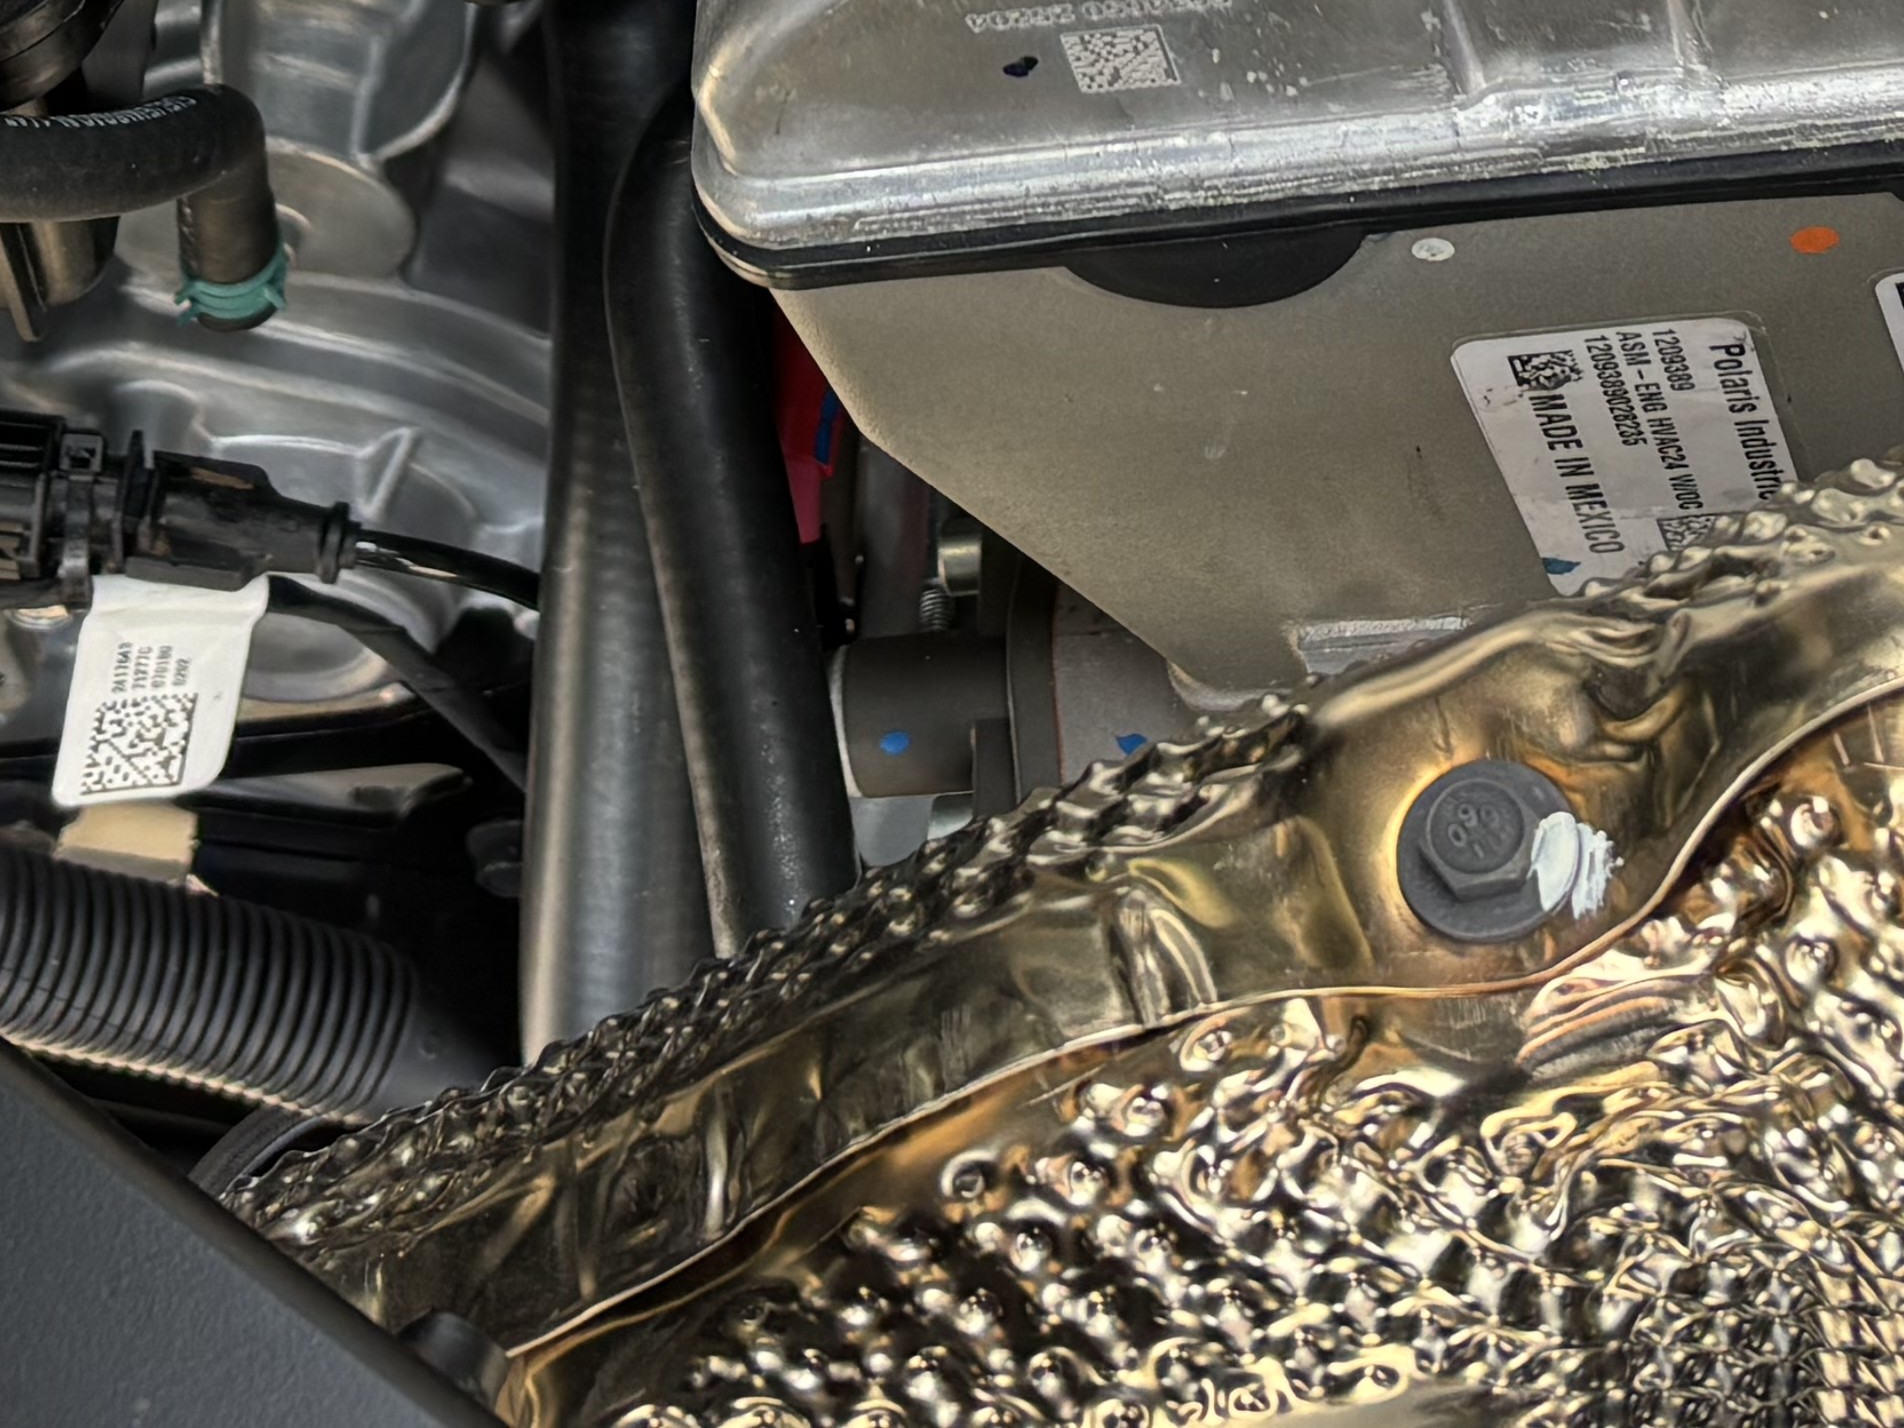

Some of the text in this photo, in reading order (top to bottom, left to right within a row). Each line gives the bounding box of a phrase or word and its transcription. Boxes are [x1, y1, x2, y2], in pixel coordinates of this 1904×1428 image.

[1616, 332, 1653, 366] ASM
[1652, 329, 1695, 391] 1209389
[1709, 343, 1757, 413] Polaris
[1584, 335, 1647, 446] 1209389028235
[1633, 383, 1665, 412] ENG
[1528, 393, 1625, 554] MADE IN MEXICO
[1645, 417, 1685, 470] HVAC24
